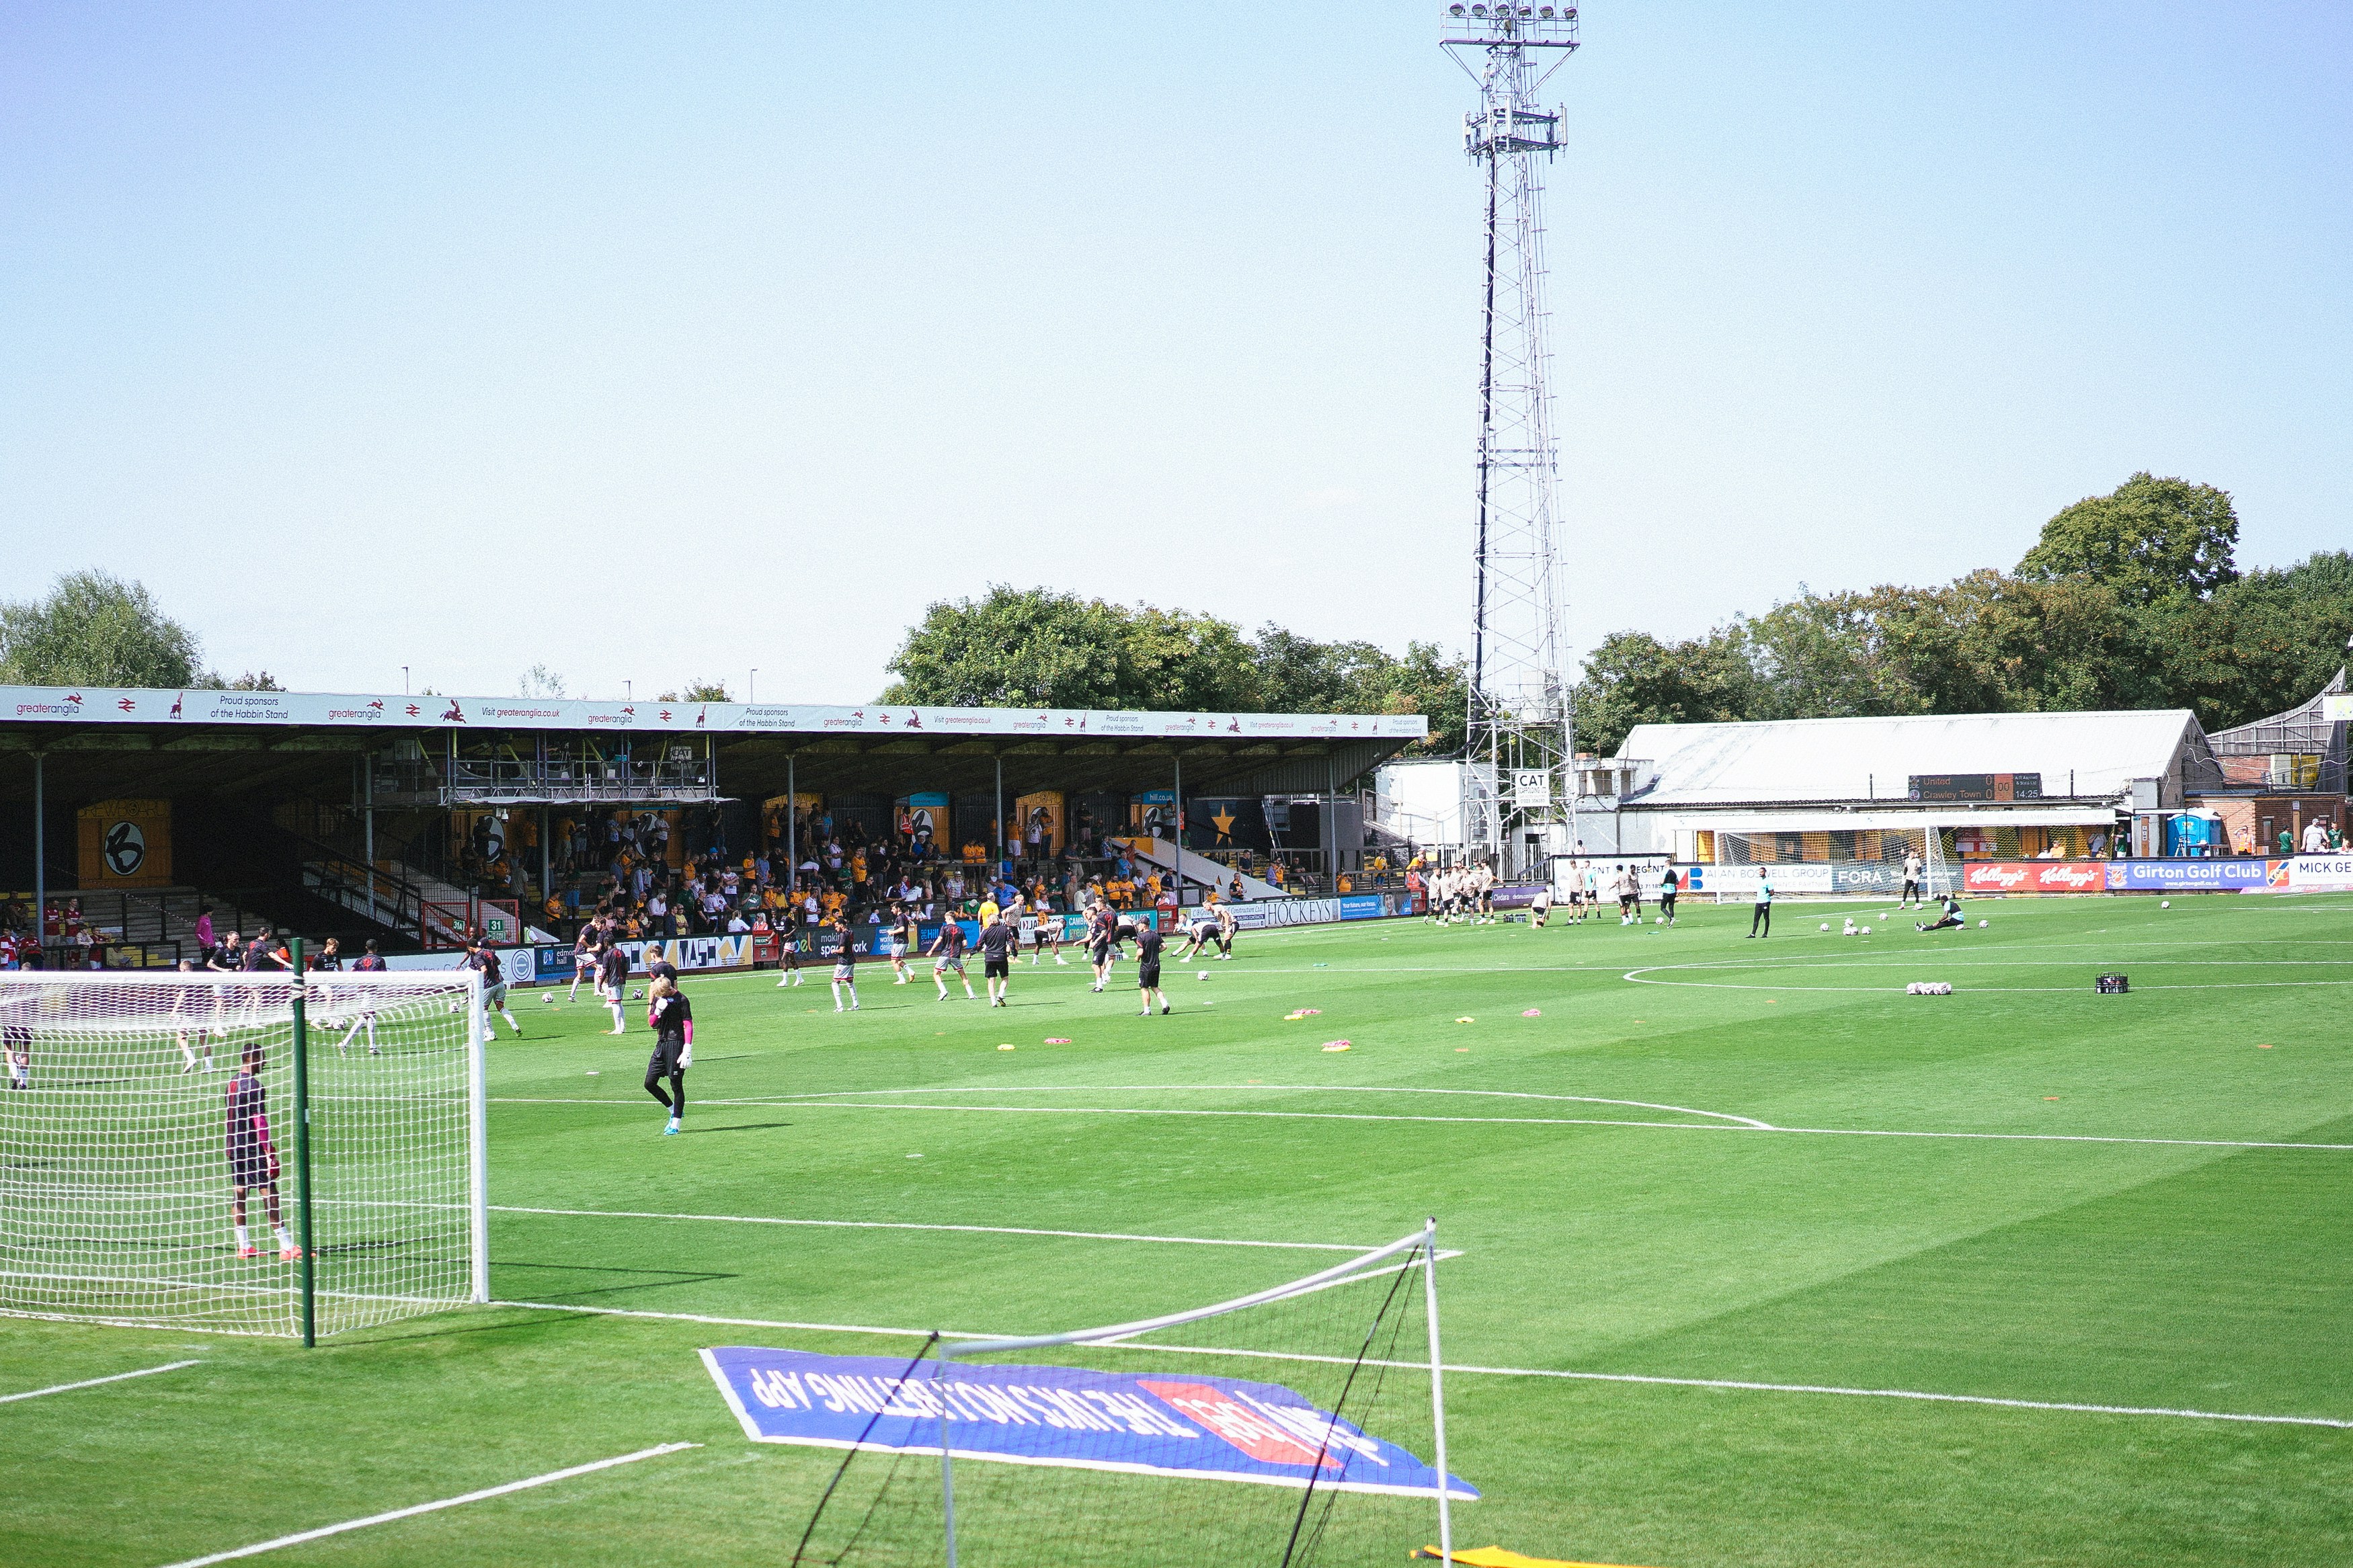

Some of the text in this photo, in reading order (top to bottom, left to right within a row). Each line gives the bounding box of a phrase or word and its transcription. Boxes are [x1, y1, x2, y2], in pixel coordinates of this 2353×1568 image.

[220, 696, 279, 708] Proud sponsors
[17, 704, 79, 717] greateranglia
[210, 709, 288, 719] of the Habbin Stand
[328, 709, 381, 721] greateranglia
[481, 707, 560, 720] Visit greateranglia.co.uk
[746, 708, 789, 718] Proud sponsors
[588, 714, 632, 726] greateranglia
[739, 719, 795, 728] of the Habbin Stand
[824, 718, 862, 728] greateranglia
[934, 716, 992, 726] Visit greateranglia.co.uk
[1106, 714, 1138, 723] Proud sponsors
[1013, 720, 1045, 731] greateranglia
[1165, 723, 1194, 732] greateranglia
[1250, 720, 1258, 729] Visit
[1520, 775, 1544, 786] CAT
[1923, 775, 1992, 786] United 0
[1998, 782, 2009, 791] 00
[1150, 793, 1173, 801] hill.co.uk
[1923, 788, 1992, 800] Crawley Town 0
[2016, 790, 2038, 798] 14:25
[1636, 865, 1665, 874] EGNT
[1792, 868, 1829, 878] GROUP
[2132, 864, 2184, 879] Girton
[2186, 864, 2222, 879] Golf
[2225, 864, 2262, 878] Club
[2300, 862, 2352, 873] MICK GE
[1839, 870, 1882, 884] FORA
[1970, 866, 2026, 887] Kellogg's
[2039, 866, 2096, 887] Kellogg's
[1493, 894, 1509, 902] Cledara
[1268, 900, 1330, 925] HOCKEYS
[453, 920, 463, 931] 31A
[491, 920, 501, 930] 31
[821, 932, 840, 943] maki
[927, 928, 939, 940] Hill
[679, 938, 717, 968] MASH
[557, 956, 567, 964] hall
[750, 1368, 812, 1409] APP
[805, 1372, 958, 1420] BETTING
[930, 1381, 1042, 1426] NO.1
[1007, 1385, 1127, 1433] UK'S
[1080, 1389, 1200, 1438] THE
